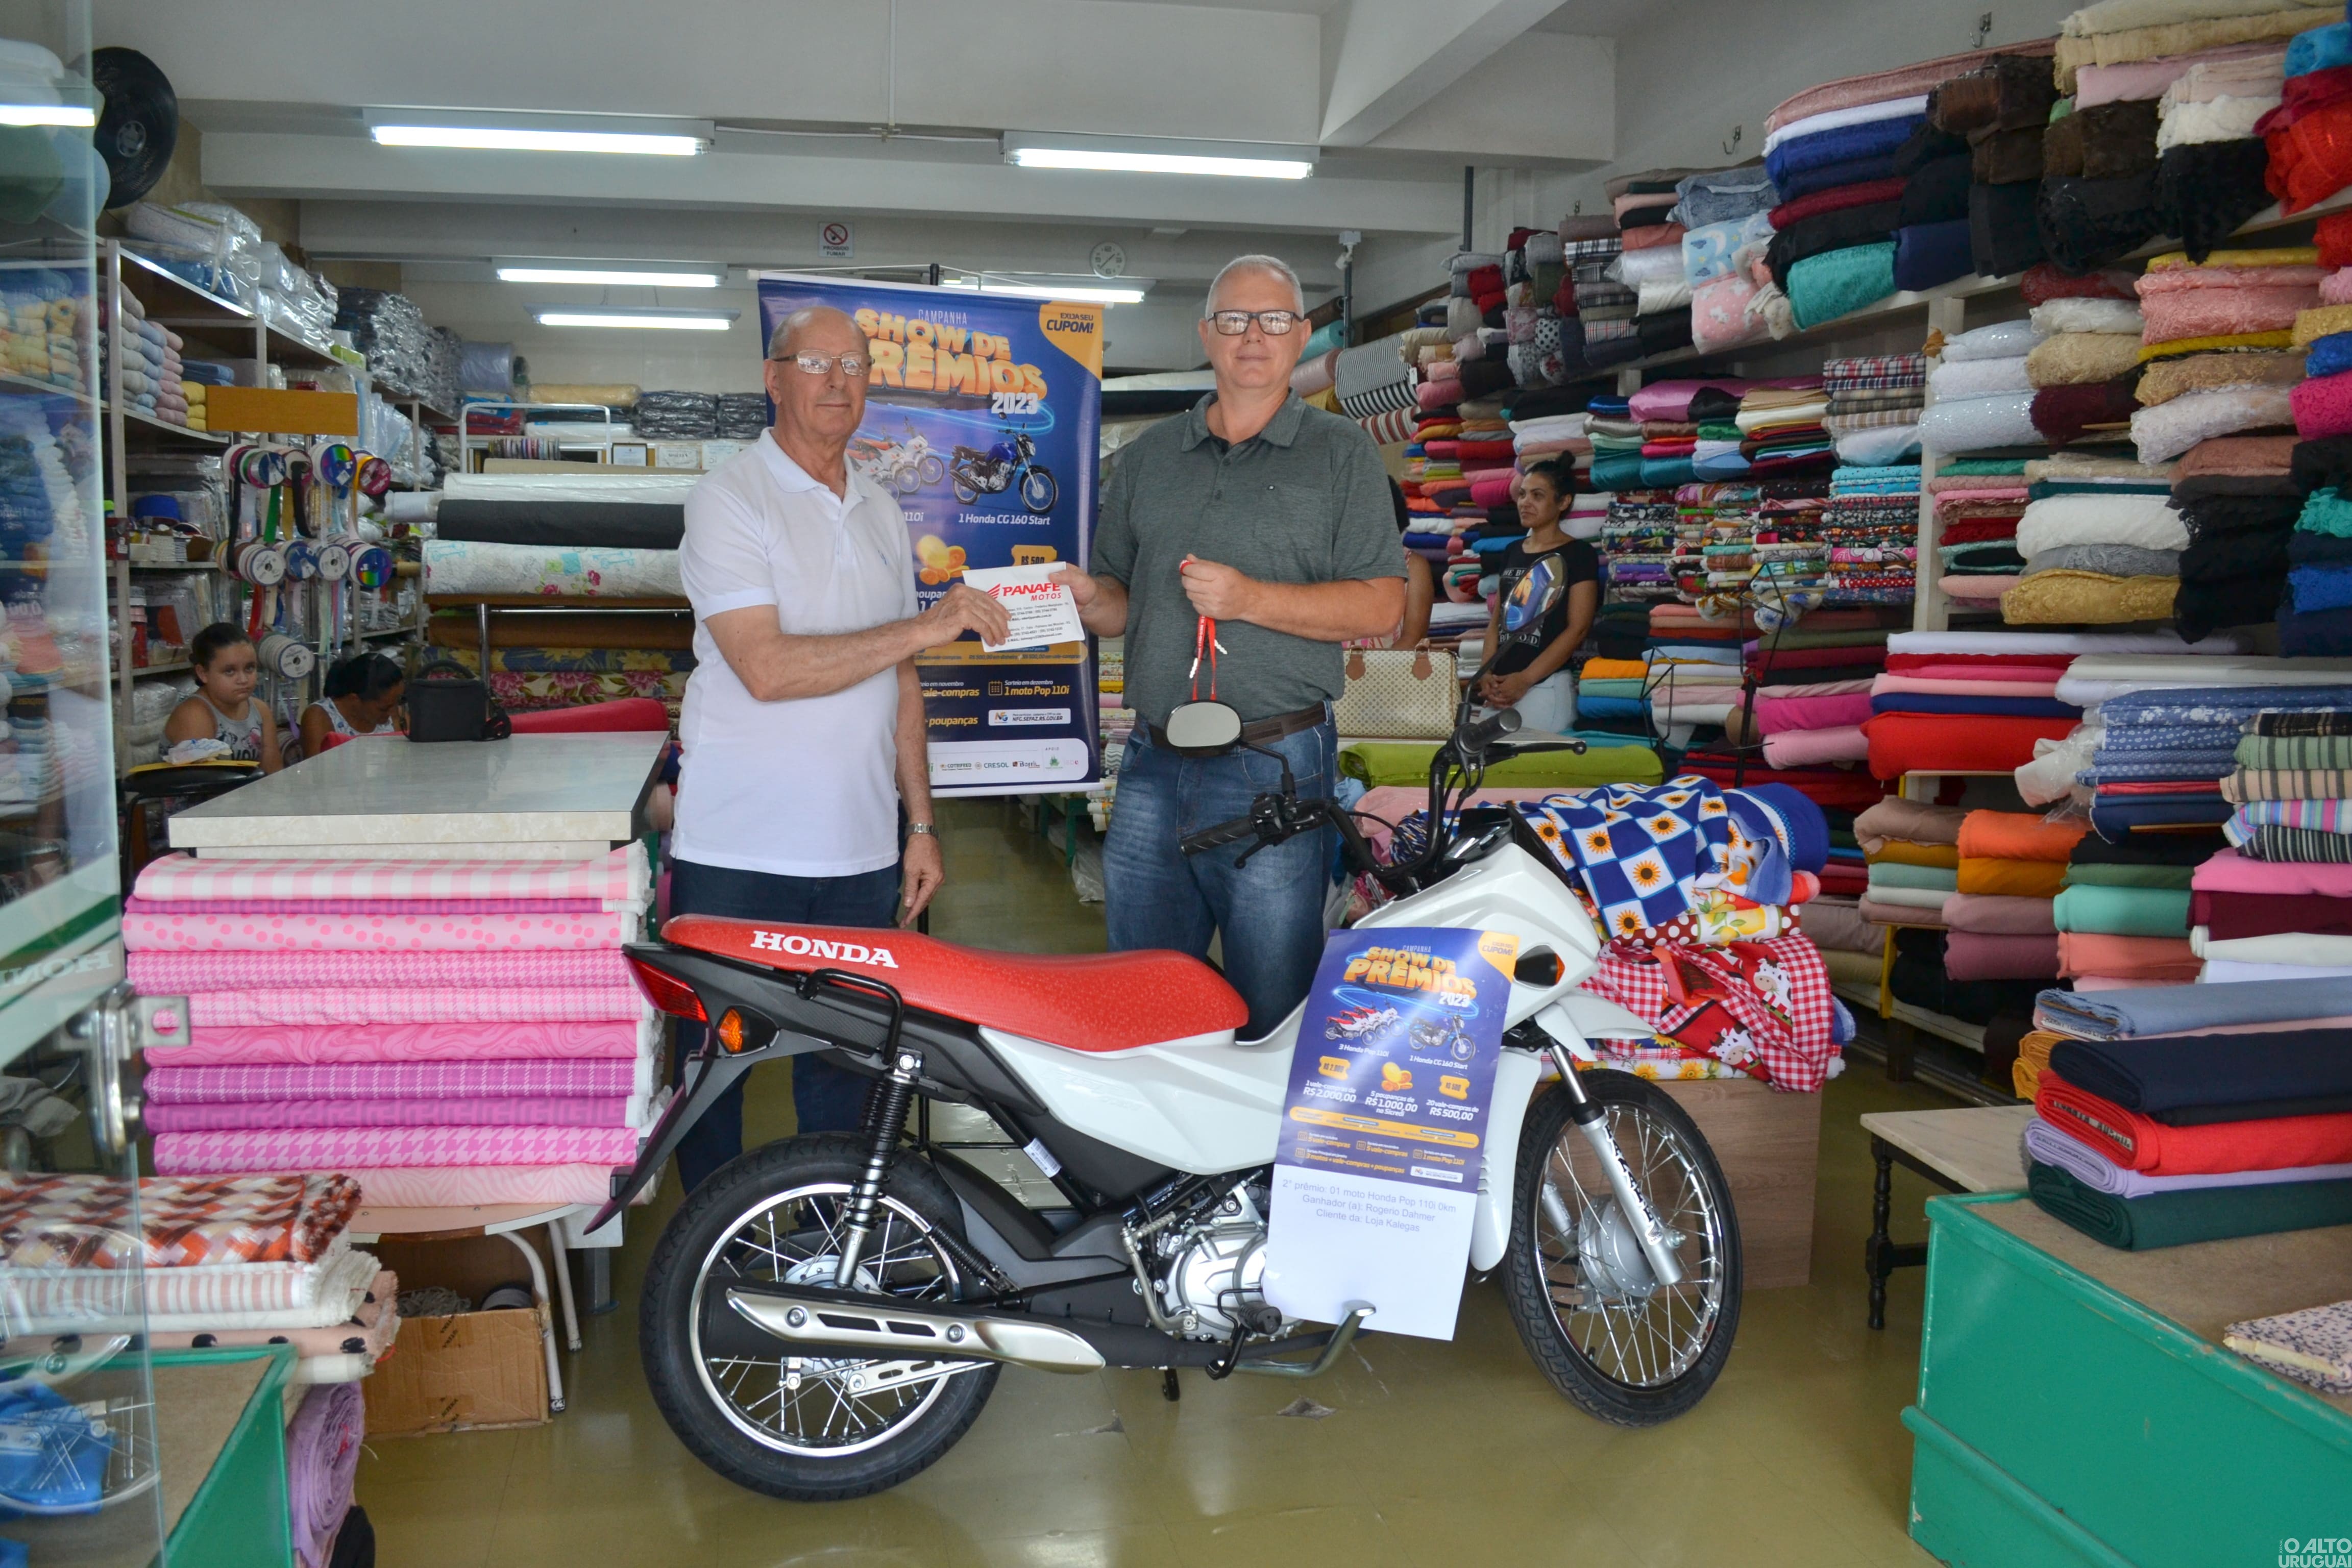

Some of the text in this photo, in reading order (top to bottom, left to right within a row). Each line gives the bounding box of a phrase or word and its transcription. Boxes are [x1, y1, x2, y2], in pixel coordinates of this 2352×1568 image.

[918, 308, 967, 325] CAMPANHA
[854, 308, 1012, 360] SHOW DE
[1046, 320, 1094, 334] CUPOM!
[868, 339, 1047, 400] RÊMIOS
[991, 392, 1039, 414] 2023
[959, 513, 1050, 525] 1 Honda CG 160 Start
[1031, 593, 1062, 602] MOTOS
[922, 688, 980, 698] ale-compras
[1004, 685, 1070, 697] 1 moto Pop 110i
[928, 717, 979, 727] poupanças
[750, 930, 899, 969] HONDA
[1403, 945, 1431, 953] CAMPANHA
[1482, 945, 1513, 956] CUPOM!
[1365, 946, 1457, 974] SHOW DE
[1343, 958, 1477, 999] PRÊMIOS
[1439, 992, 1470, 1008] 2023
[1344, 1044, 1363, 1054] Honda
[1364, 1047, 1377, 1056] Pop
[1413, 1056, 1433, 1064] Honda
[1453, 1062, 1468, 1070] Start
[1310, 1081, 1348, 1093] vale-compras
[1303, 1087, 1357, 1102] R$ 2.000,00
[1376, 1091, 1407, 1103] poupanças
[1365, 1097, 1418, 1113] R$ 1.000,00
[1434, 1100, 1472, 1112] vale-compras
[1386, 1108, 1405, 1117] Sicredi
[1429, 1107, 1474, 1121] R$ 500,00
[1312, 1137, 1351, 1148] vale-compras
[1370, 1146, 1408, 1158] vale-compras
[1333, 1158, 1370, 1169] vale-compras
[1374, 1164, 1405, 1174] poupanças
[1294, 1180, 1327, 1193] prêmio:
[1330, 1186, 1340, 1196] 01
[1343, 1189, 1365, 1199] moto
[1368, 1192, 1396, 1203] Honda
[1400, 1195, 1416, 1207] Pop
[1419, 1199, 1436, 1209] 110i
[1438, 1203, 1456, 1213] 0km
[1303, 1194, 1435, 1222] Ganhador (a): Rogerio Dahmer
[1316, 1209, 1420, 1233] Cliente da: Loja Kalegas
